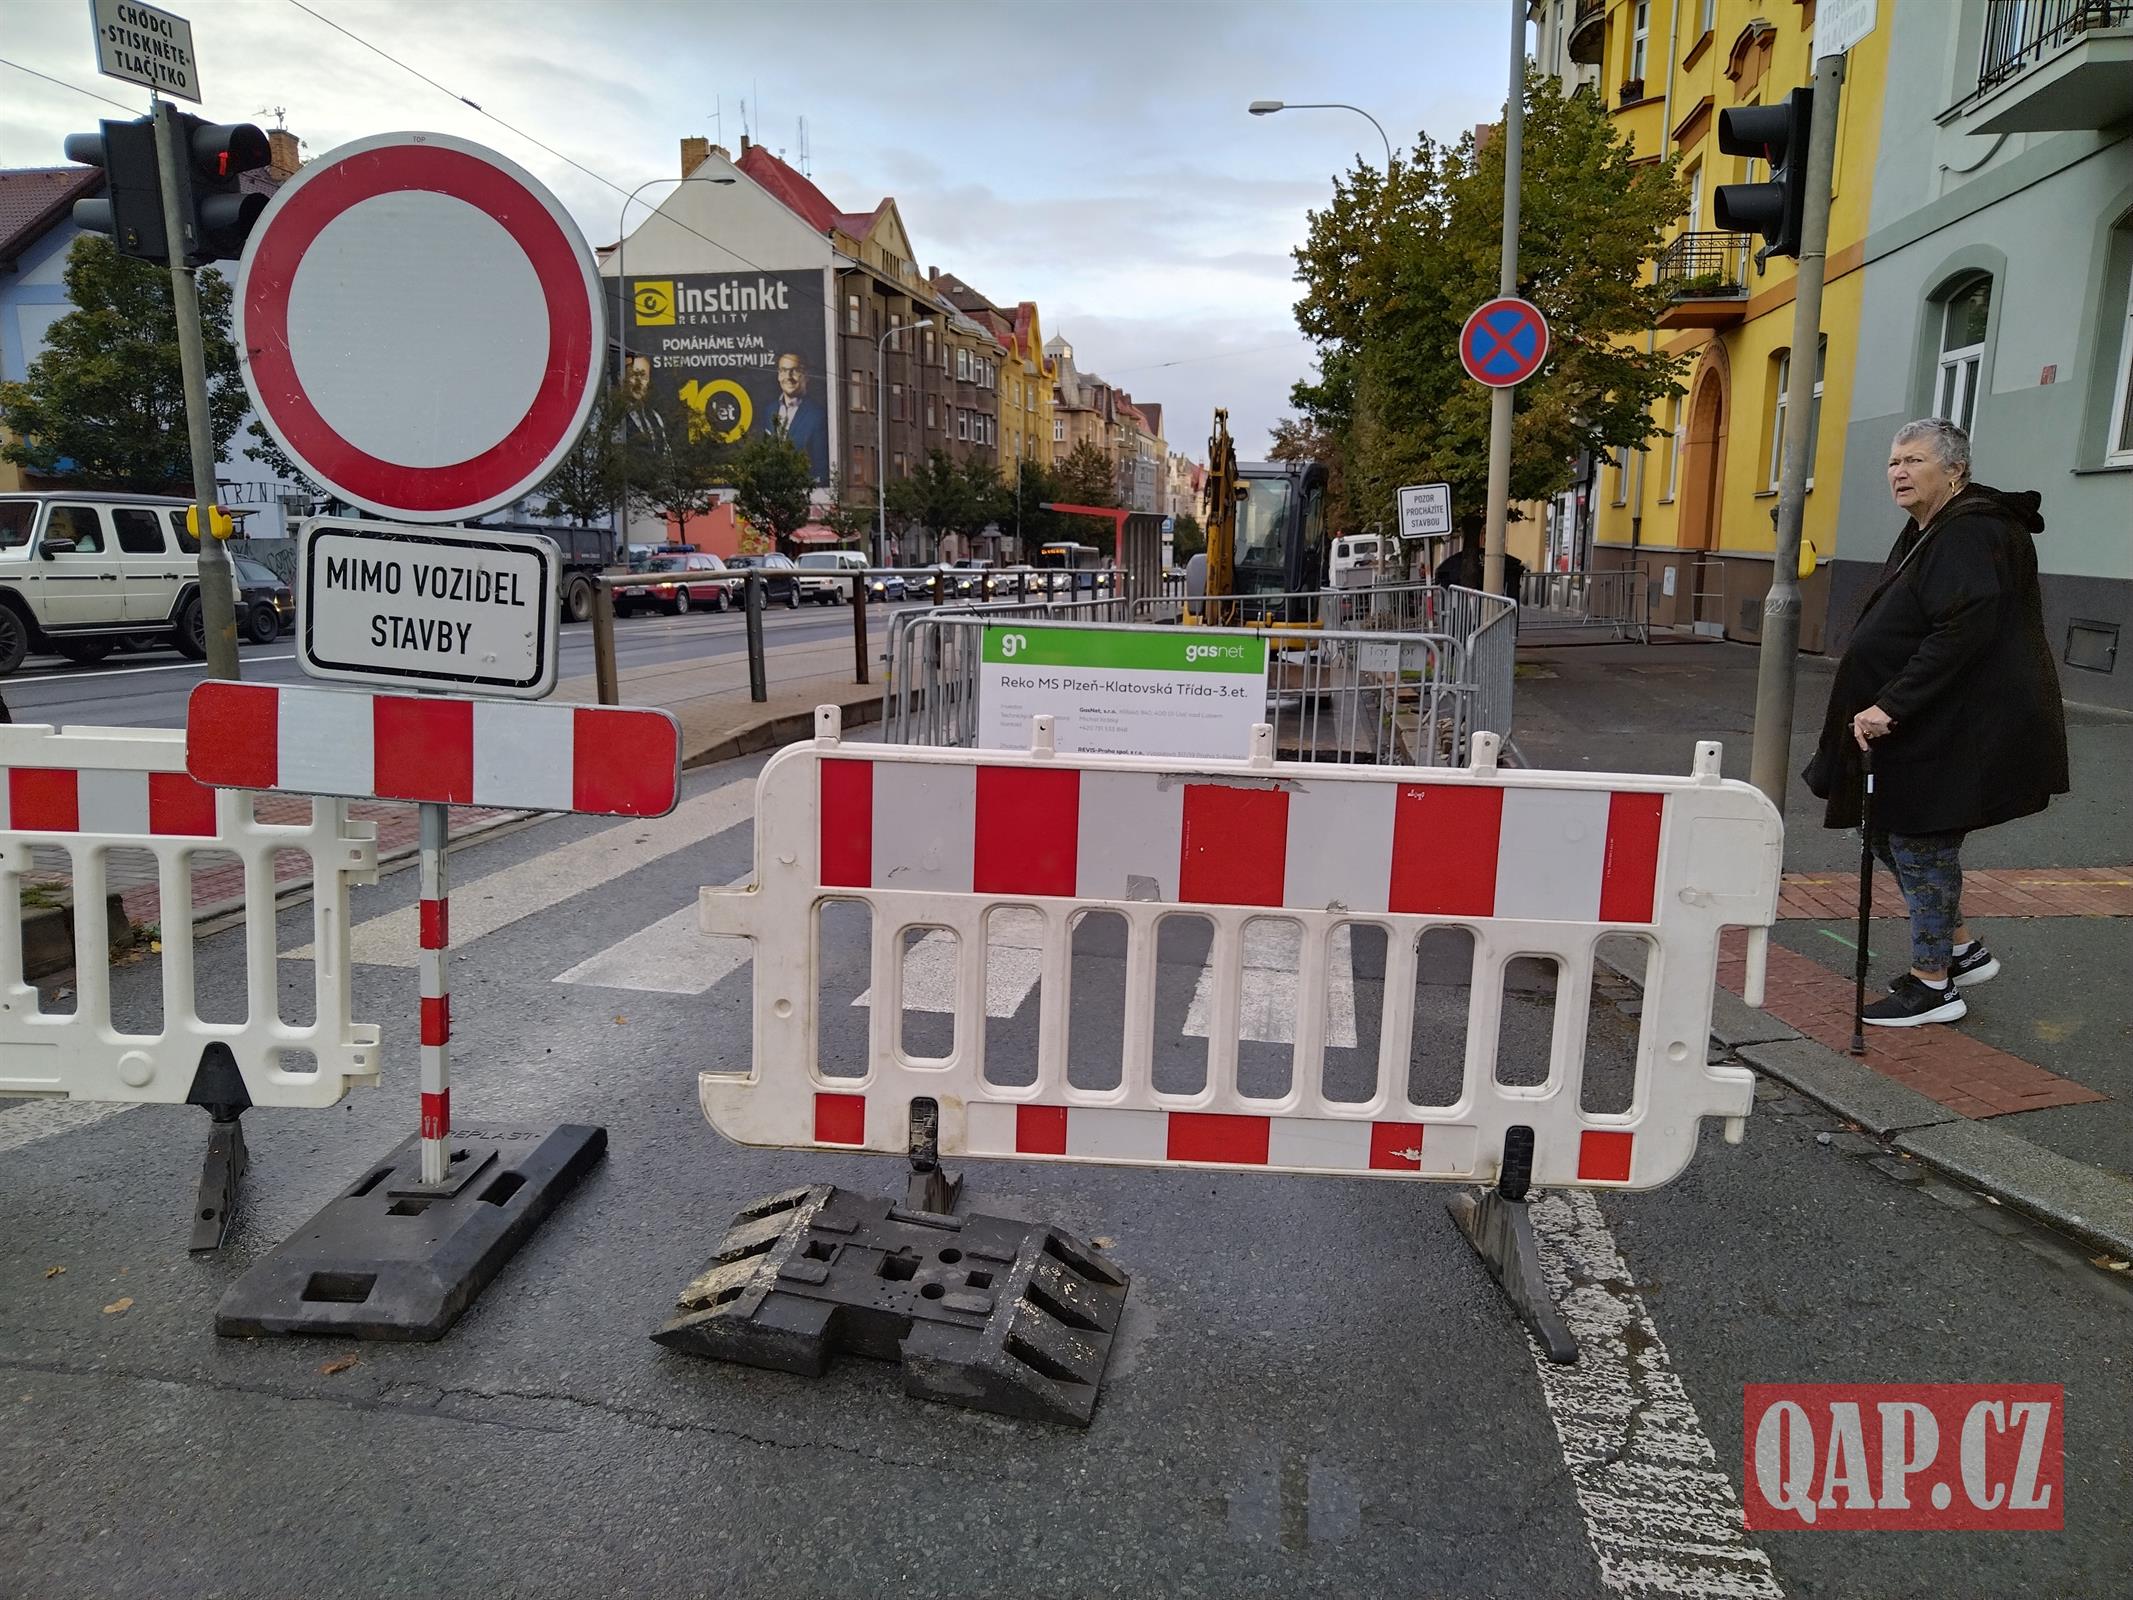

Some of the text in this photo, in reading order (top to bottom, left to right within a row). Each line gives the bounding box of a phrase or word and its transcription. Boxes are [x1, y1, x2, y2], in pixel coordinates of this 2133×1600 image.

[118, 4, 173, 39] CHODCI
[108, 25, 186, 66] STISKNĚTE
[114, 50, 186, 88] TLAČÍTKO
[677, 278, 789, 313] instinkt
[678, 313, 748, 325] REALITY
[662, 334, 764, 351] POMÁHÁME VÁM
[653, 351, 776, 368] S NEMOVITOSTMI JIŽ
[1413, 495, 1435, 504] POZOR
[1406, 505, 1444, 516] PROCHÁZÍTE
[1411, 518, 1440, 528] STAVBOU
[326, 556, 401, 595] MIMO
[413, 564, 525, 606] VOZIDEL
[371, 614, 472, 655] STAVBY
[1186, 645, 1244, 662] gasnet
[1001, 676, 1248, 698] Reko MS Plzeň-Klatovská Třída-3.et.
